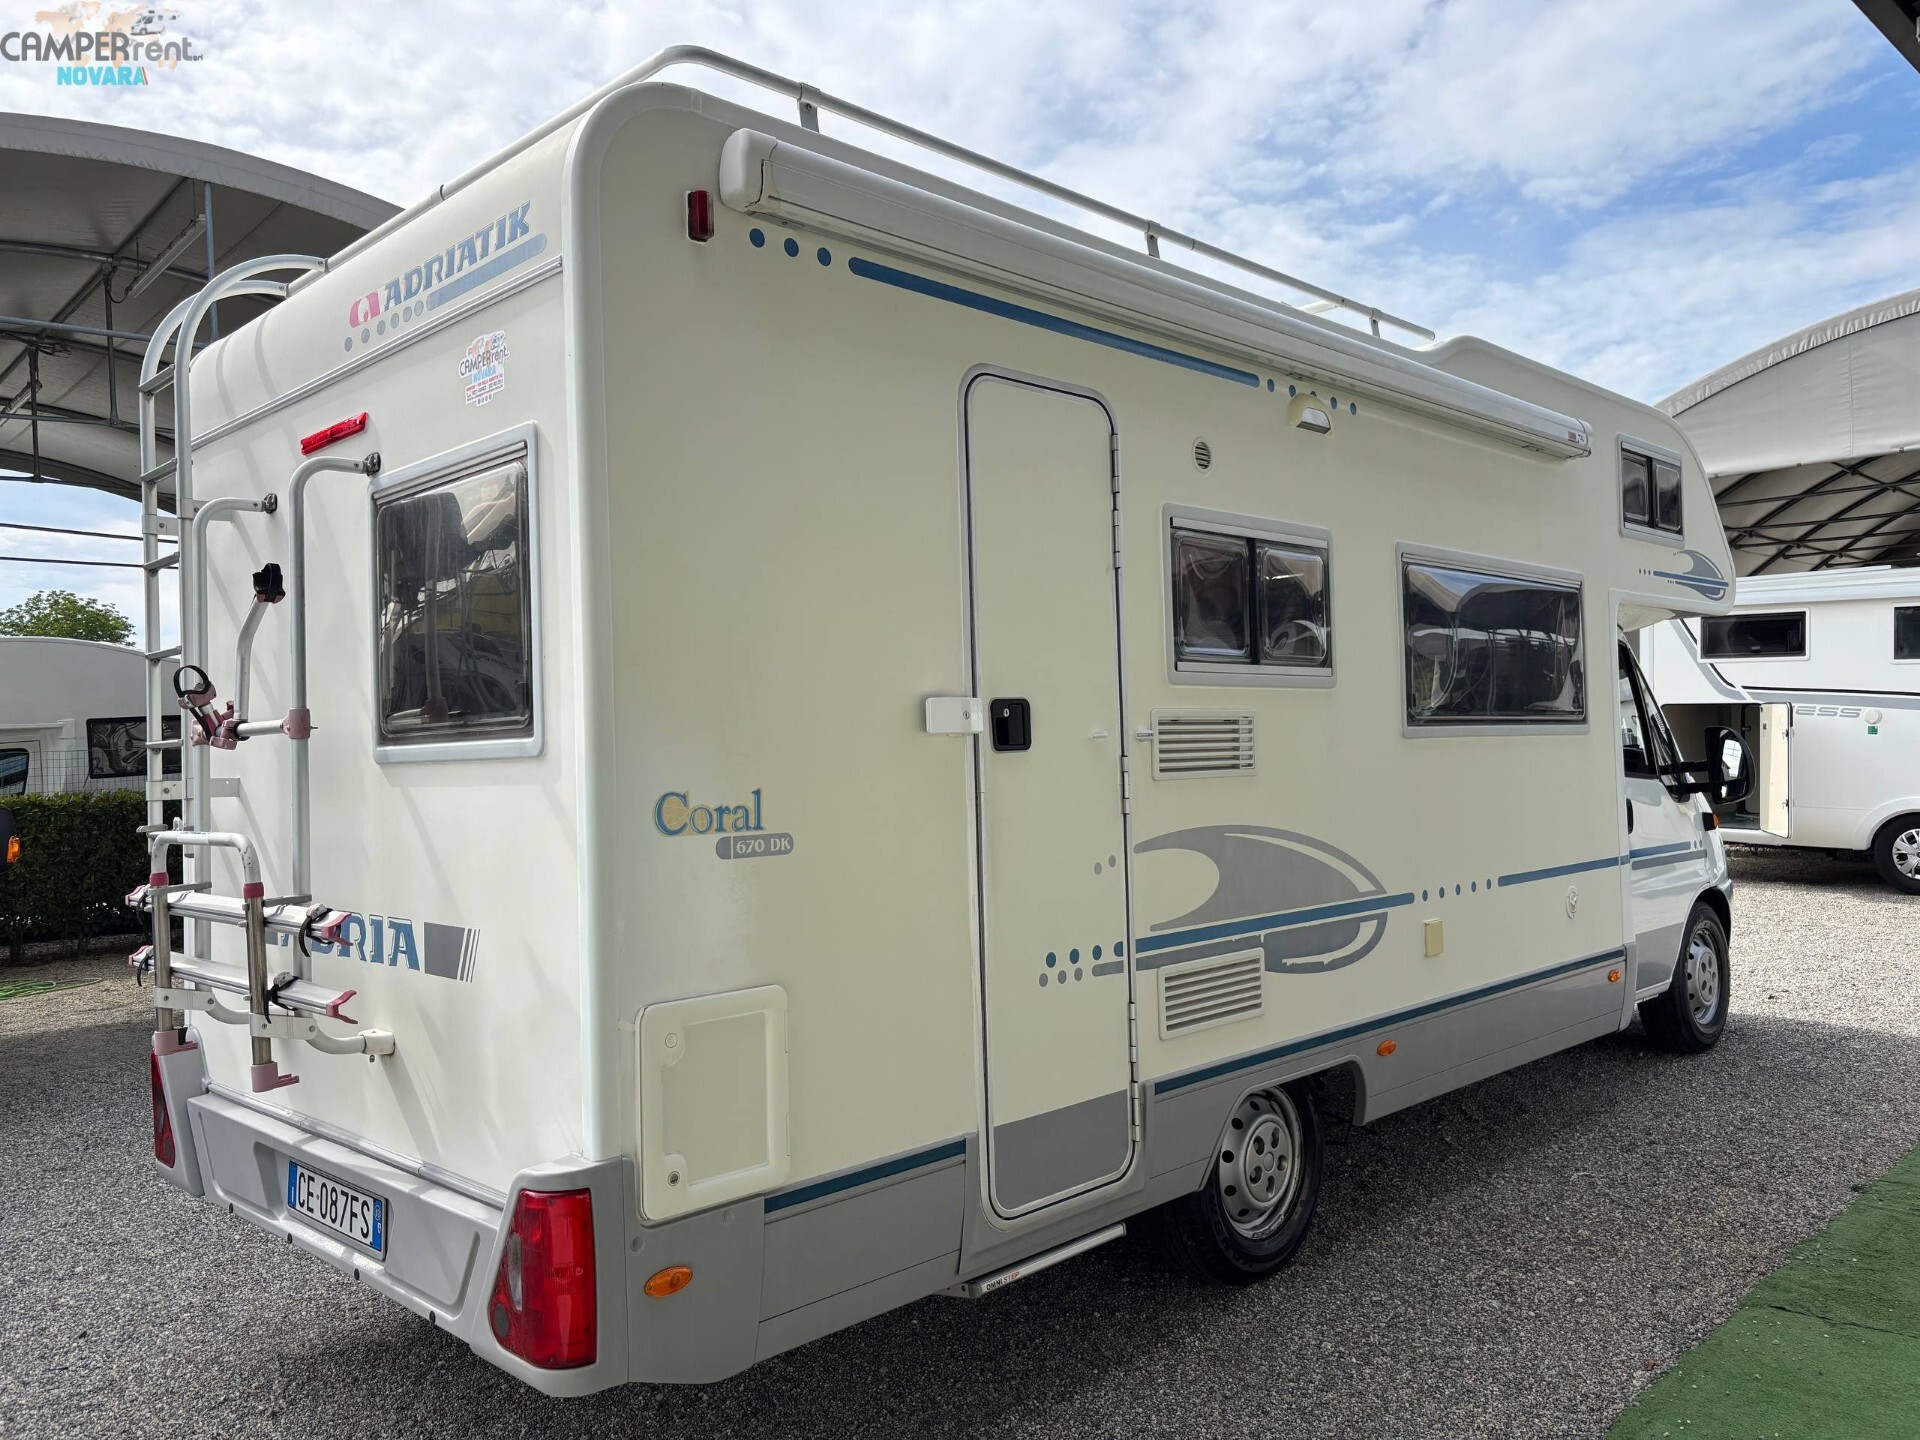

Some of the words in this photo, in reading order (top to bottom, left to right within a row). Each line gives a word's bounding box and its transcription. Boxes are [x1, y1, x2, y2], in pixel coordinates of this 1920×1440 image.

[383, 200, 531, 312] ADRIATIK
[1793, 705, 1862, 719] ESS
[655, 788, 764, 836] Coral
[736, 838, 765, 854] 670
[770, 836, 791, 851] DK
